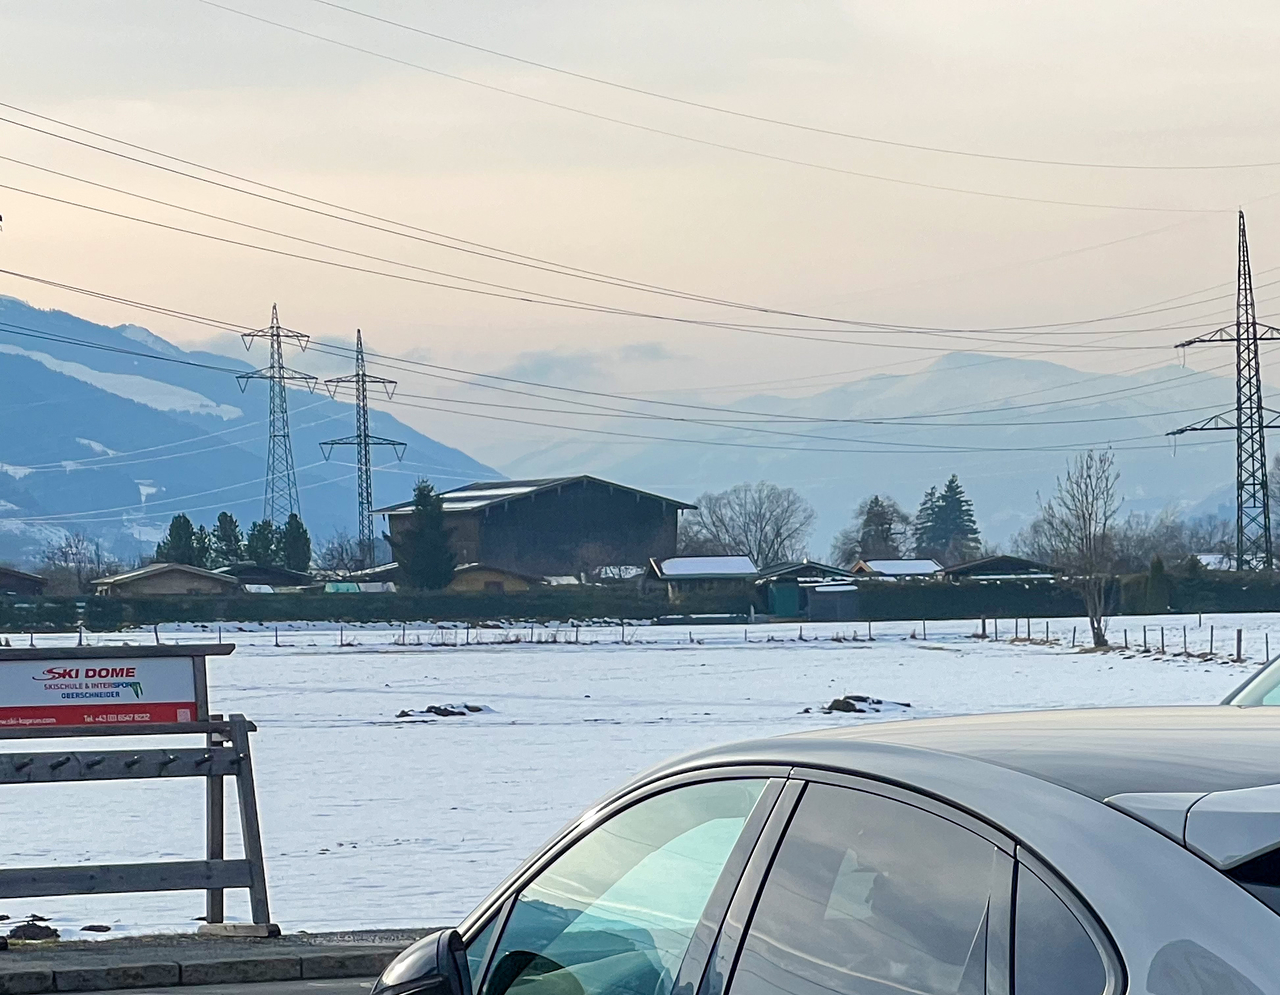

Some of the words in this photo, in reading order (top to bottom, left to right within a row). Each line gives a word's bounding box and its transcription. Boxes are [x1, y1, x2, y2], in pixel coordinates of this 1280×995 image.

[32, 666, 80, 681] SKI
[84, 667, 136, 679] DOME
[44, 682, 83, 690] SKISCHULE
[61, 691, 120, 699] OBERSCHNEIDER
